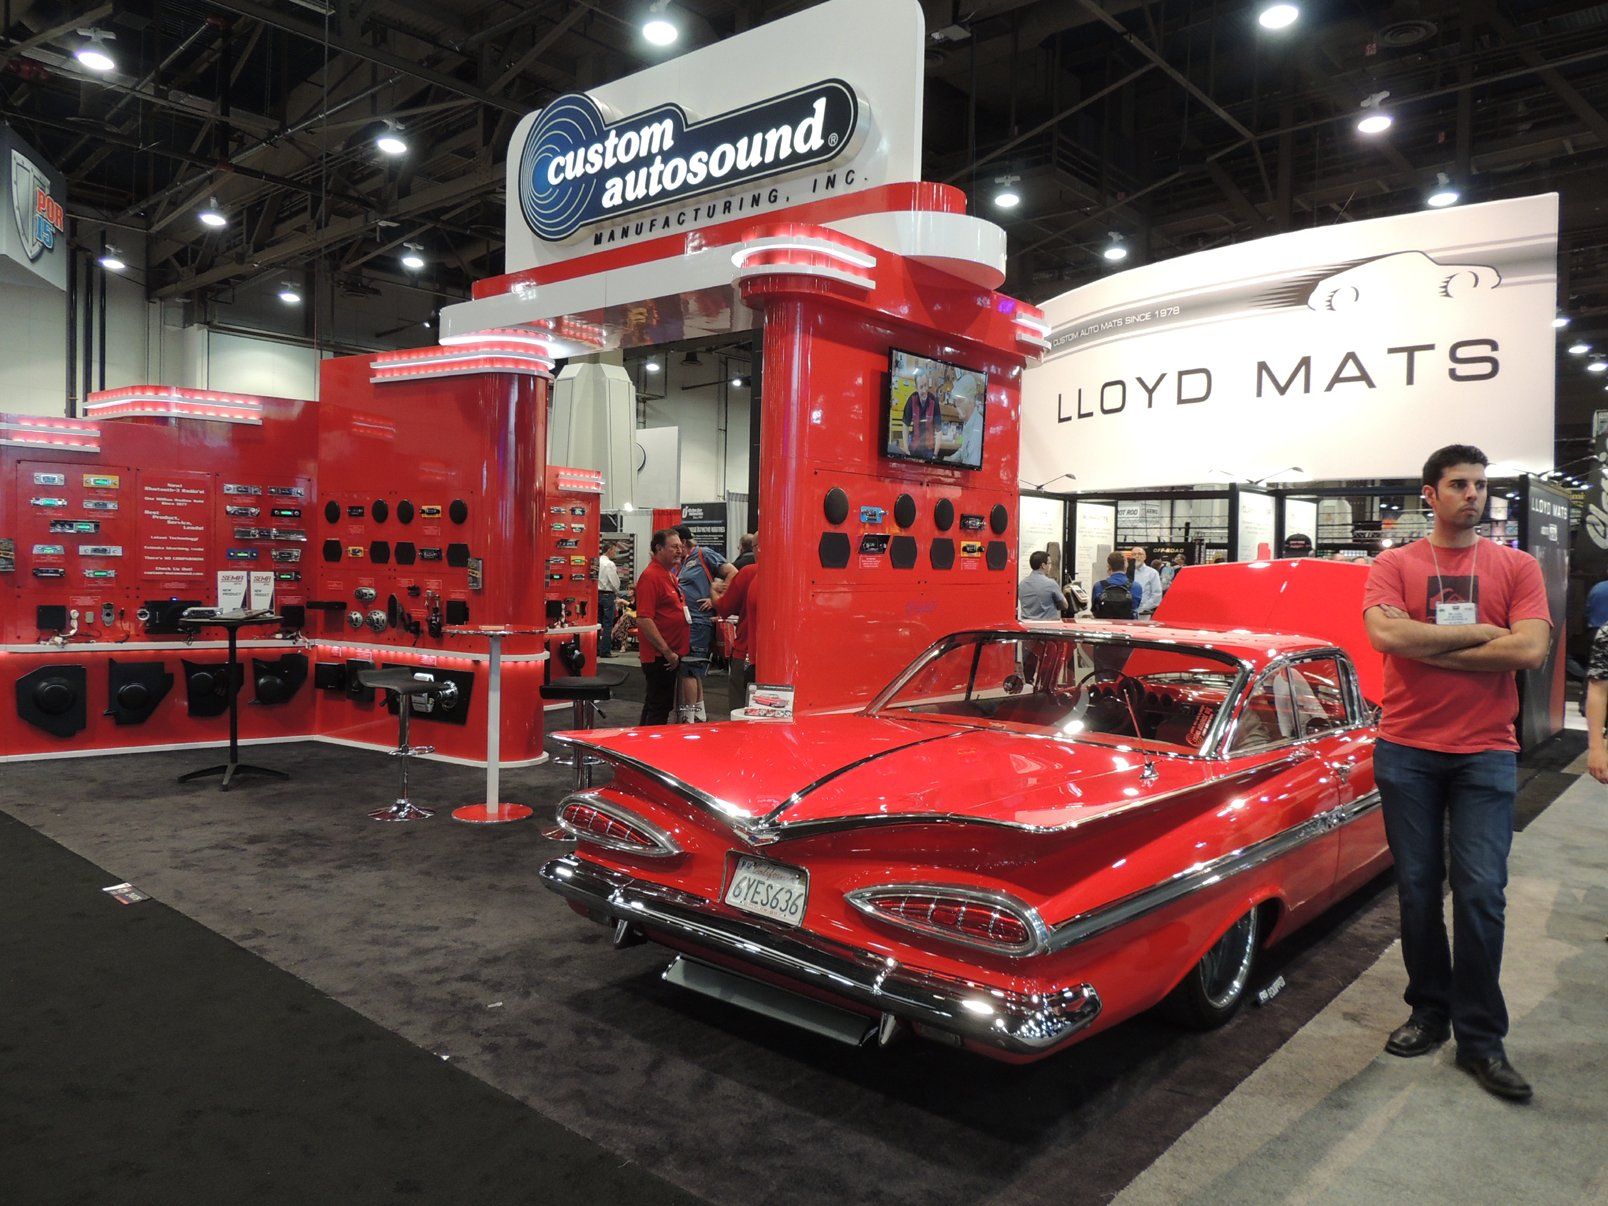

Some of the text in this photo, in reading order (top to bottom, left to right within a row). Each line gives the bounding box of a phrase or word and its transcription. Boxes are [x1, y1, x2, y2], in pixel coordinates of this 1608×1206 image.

[547, 118, 674, 186] custom
[601, 97, 827, 208] autosound
[36, 186, 64, 233] POR
[593, 169, 869, 246] MANUFACTURING, INC.
[1052, 306, 1180, 347] CUSTOM AUTO MATS SINCE 1978
[1056, 338, 1501, 424] LLOYD MATS
[1531, 497, 1568, 520] LLOYD MATS
[733, 876, 804, 916] 6YES636
